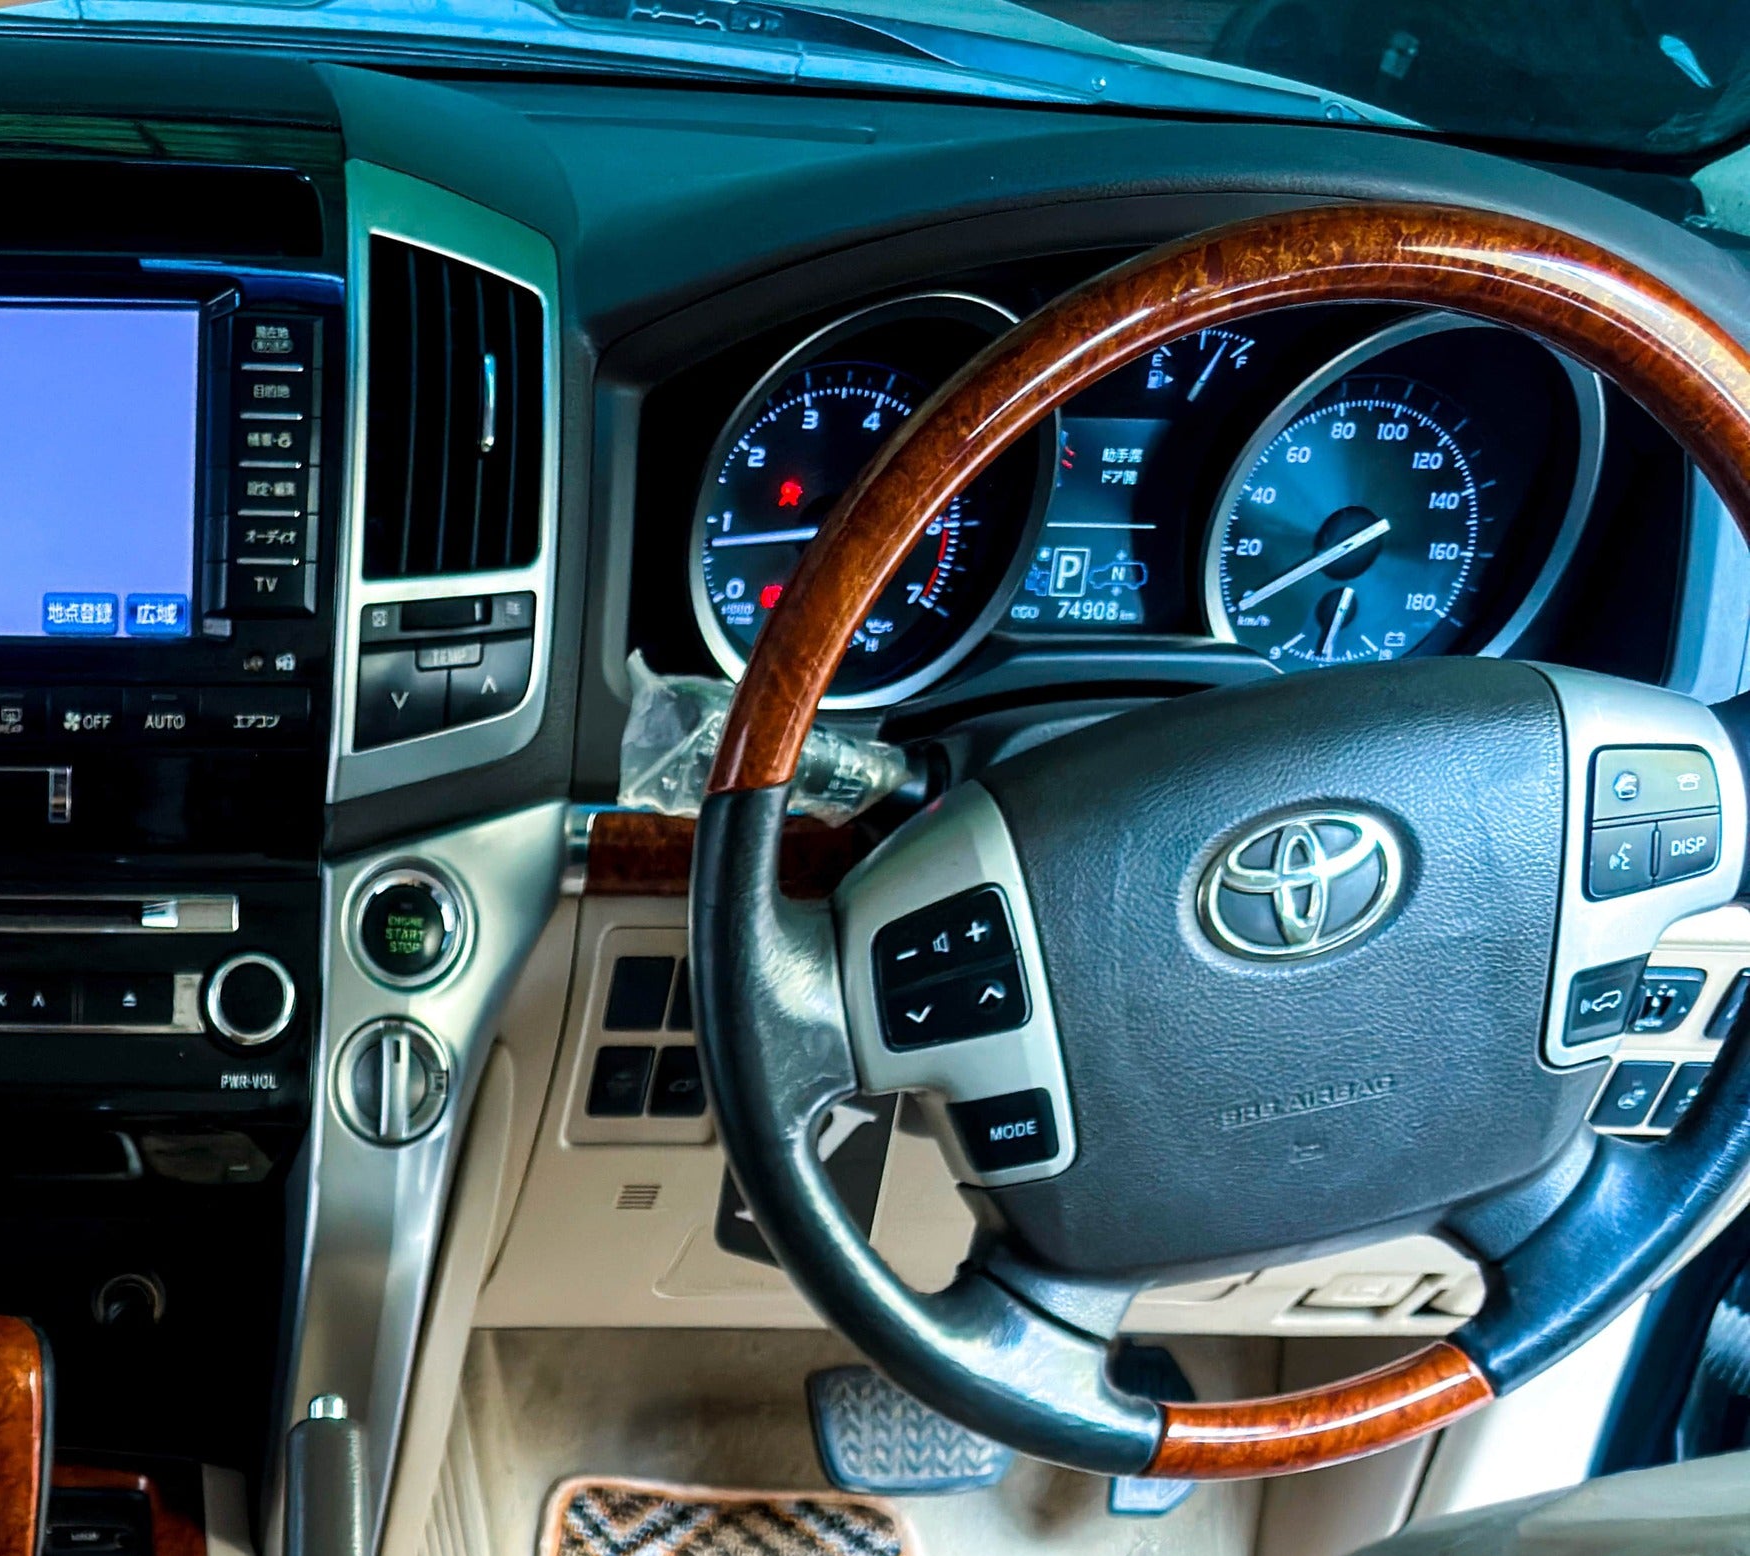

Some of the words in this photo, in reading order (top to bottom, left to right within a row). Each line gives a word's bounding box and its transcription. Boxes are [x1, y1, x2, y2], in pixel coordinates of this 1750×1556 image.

[1152, 353, 1164, 367] E
[1236, 355, 1248, 369] F
[801, 409, 819, 430] 3
[862, 411, 881, 431] 4
[1331, 422, 1356, 440] 80
[1377, 422, 1409, 441] 100
[747, 447, 766, 467] 2
[1286, 446, 1312, 464] 60
[1412, 451, 1443, 470] 120
[1251, 487, 1276, 504] 40
[1429, 491, 1460, 510] 140
[722, 511, 732, 532] 1
[1236, 538, 1262, 557] 20
[1429, 542, 1460, 561] 160
[1057, 554, 1082, 590] P
[1111, 565, 1127, 582] N
[254, 576, 278, 593] TV
[725, 578, 745, 599] 0
[906, 583, 923, 604] 7
[1057, 600, 1119, 621] 74908
[1405, 593, 1437, 612] 180
[47, 601, 113, 625] 地点登録
[136, 603, 178, 626] 広域
[432, 650, 468, 667] TEMP
[1269, 646, 1282, 660] 9
[82, 714, 112, 730] OFF
[144, 714, 186, 730] AUTO
[232, 714, 281, 729] エアコン
[1670, 836, 1708, 857] DISP
[385, 927, 426, 941] START
[389, 940, 422, 954] STOP
[1286, 1074, 1396, 1110] AIRBAG
[989, 1119, 1038, 1142] MODE
